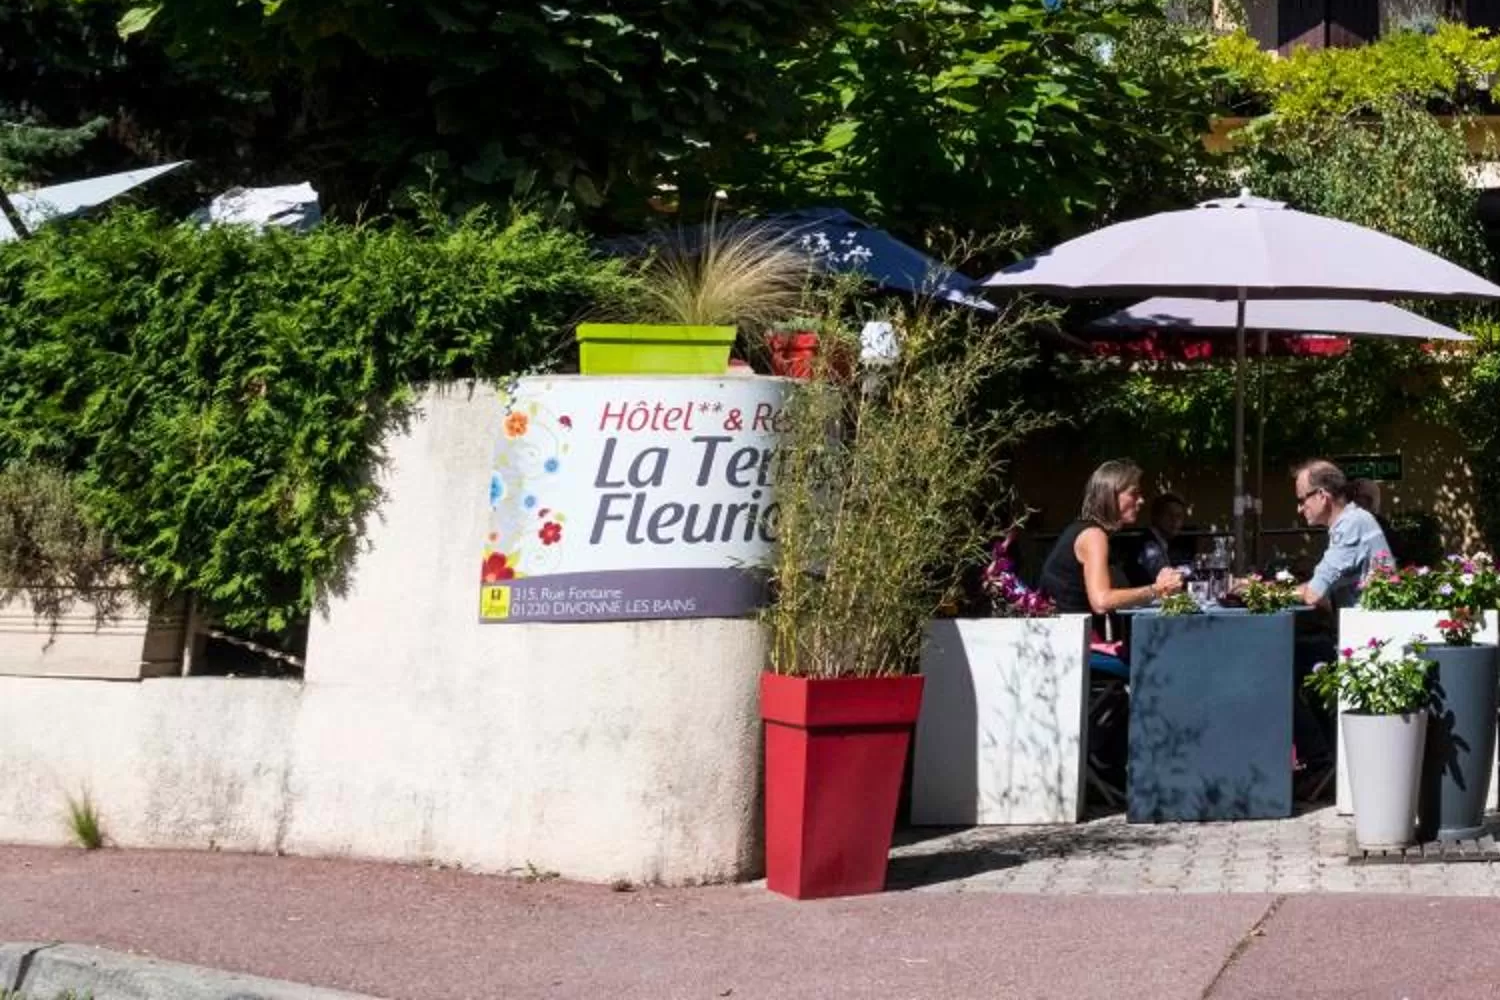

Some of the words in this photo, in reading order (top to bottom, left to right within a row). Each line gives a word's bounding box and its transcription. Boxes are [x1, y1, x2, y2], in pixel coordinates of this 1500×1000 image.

[599, 400, 694, 432] Hôtel
[723, 407, 743, 431] &
[593, 436, 670, 489] La
[541, 586, 565, 601] Rue
[568, 585, 624, 601] Fontaine
[553, 600, 621, 616] DIVONNE
[625, 599, 649, 614] LES
[653, 597, 697, 613] BAINS
